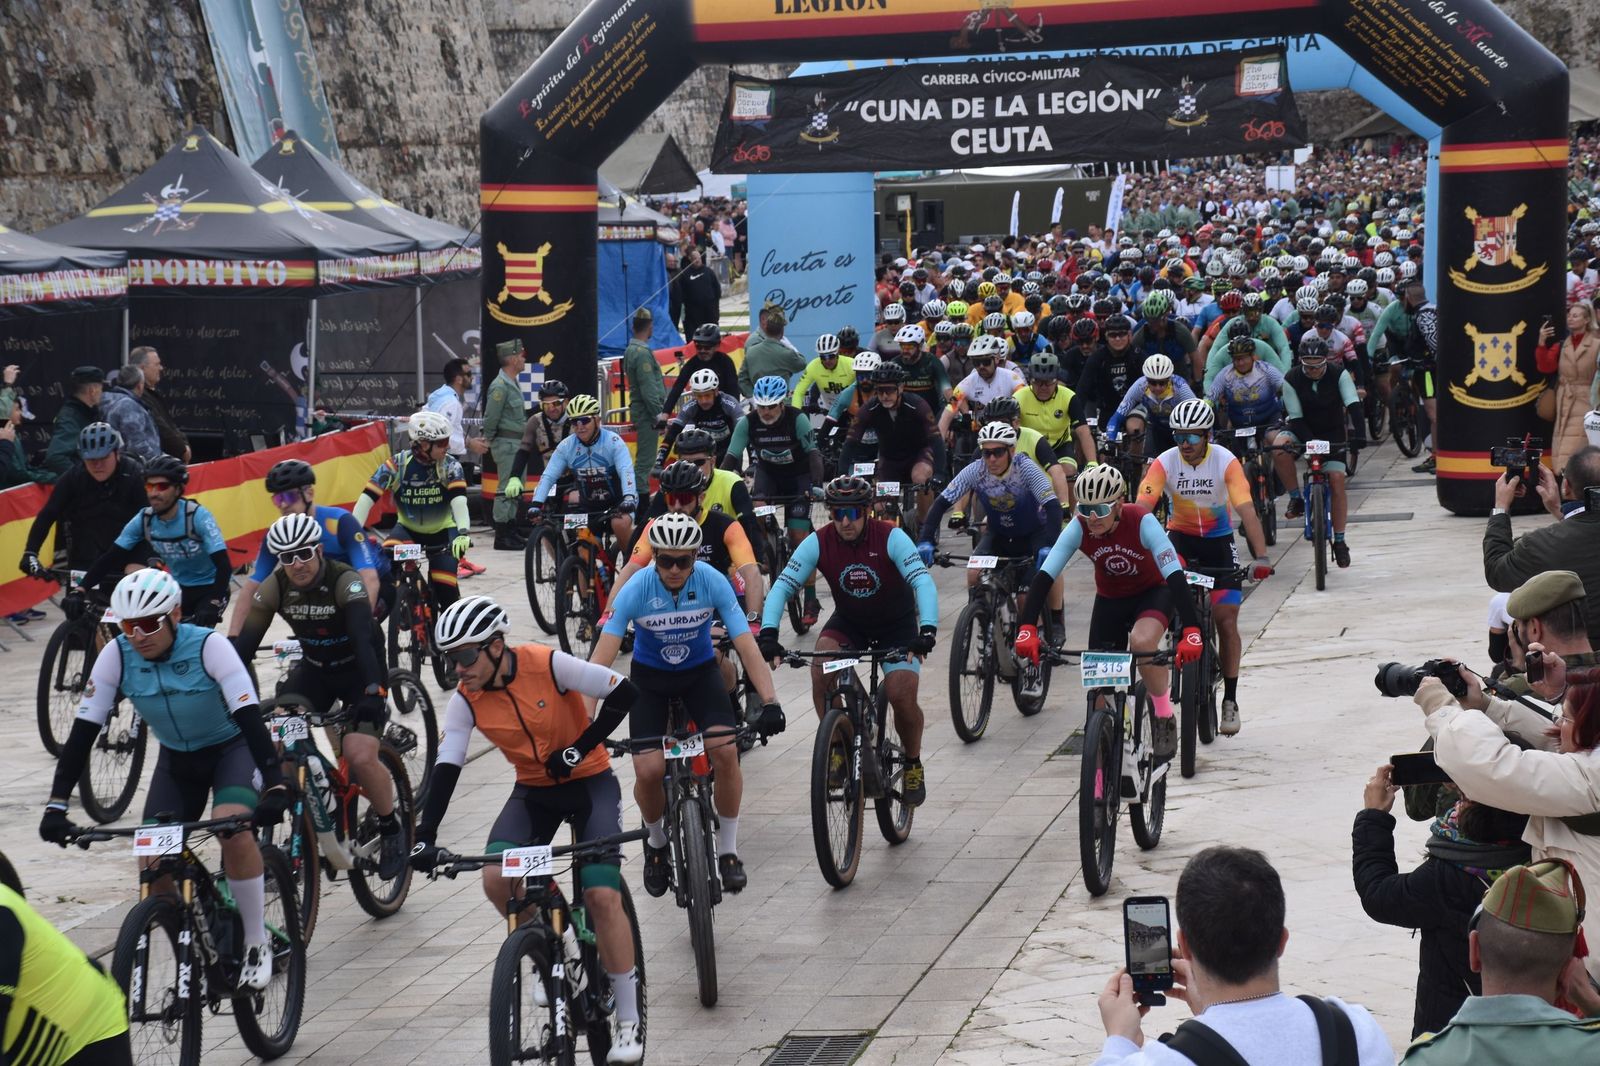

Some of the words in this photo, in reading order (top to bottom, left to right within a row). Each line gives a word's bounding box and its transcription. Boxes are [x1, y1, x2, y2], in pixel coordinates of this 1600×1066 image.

[1428, 0, 1444, 15] de
[1442, 11, 1459, 26] la
[1456, 18, 1510, 70] Muerte
[518, 70, 566, 118] Espíritu
[566, 45, 581, 71] del
[922, 72, 979, 86] CARRERA
[982, 67, 1080, 84] CÍVICO-MILITAR
[951, 97, 986, 120] DE
[995, 94, 1029, 117] LA
[950, 125, 1053, 155] CEUTA
[128, 259, 287, 286] EPORTIVO
[760, 248, 827, 277] Ceuta
[833, 252, 856, 268] es
[765, 283, 857, 323] Deporte
[1176, 477, 1189, 489] FIT
[283, 604, 337, 615] SENDEROS
[645, 617, 667, 627] SAN
[669, 610, 710, 625] URBANO
[157, 835, 173, 847] 28
[523, 855, 547, 869] 351
[178, 963, 192, 998] FOX
